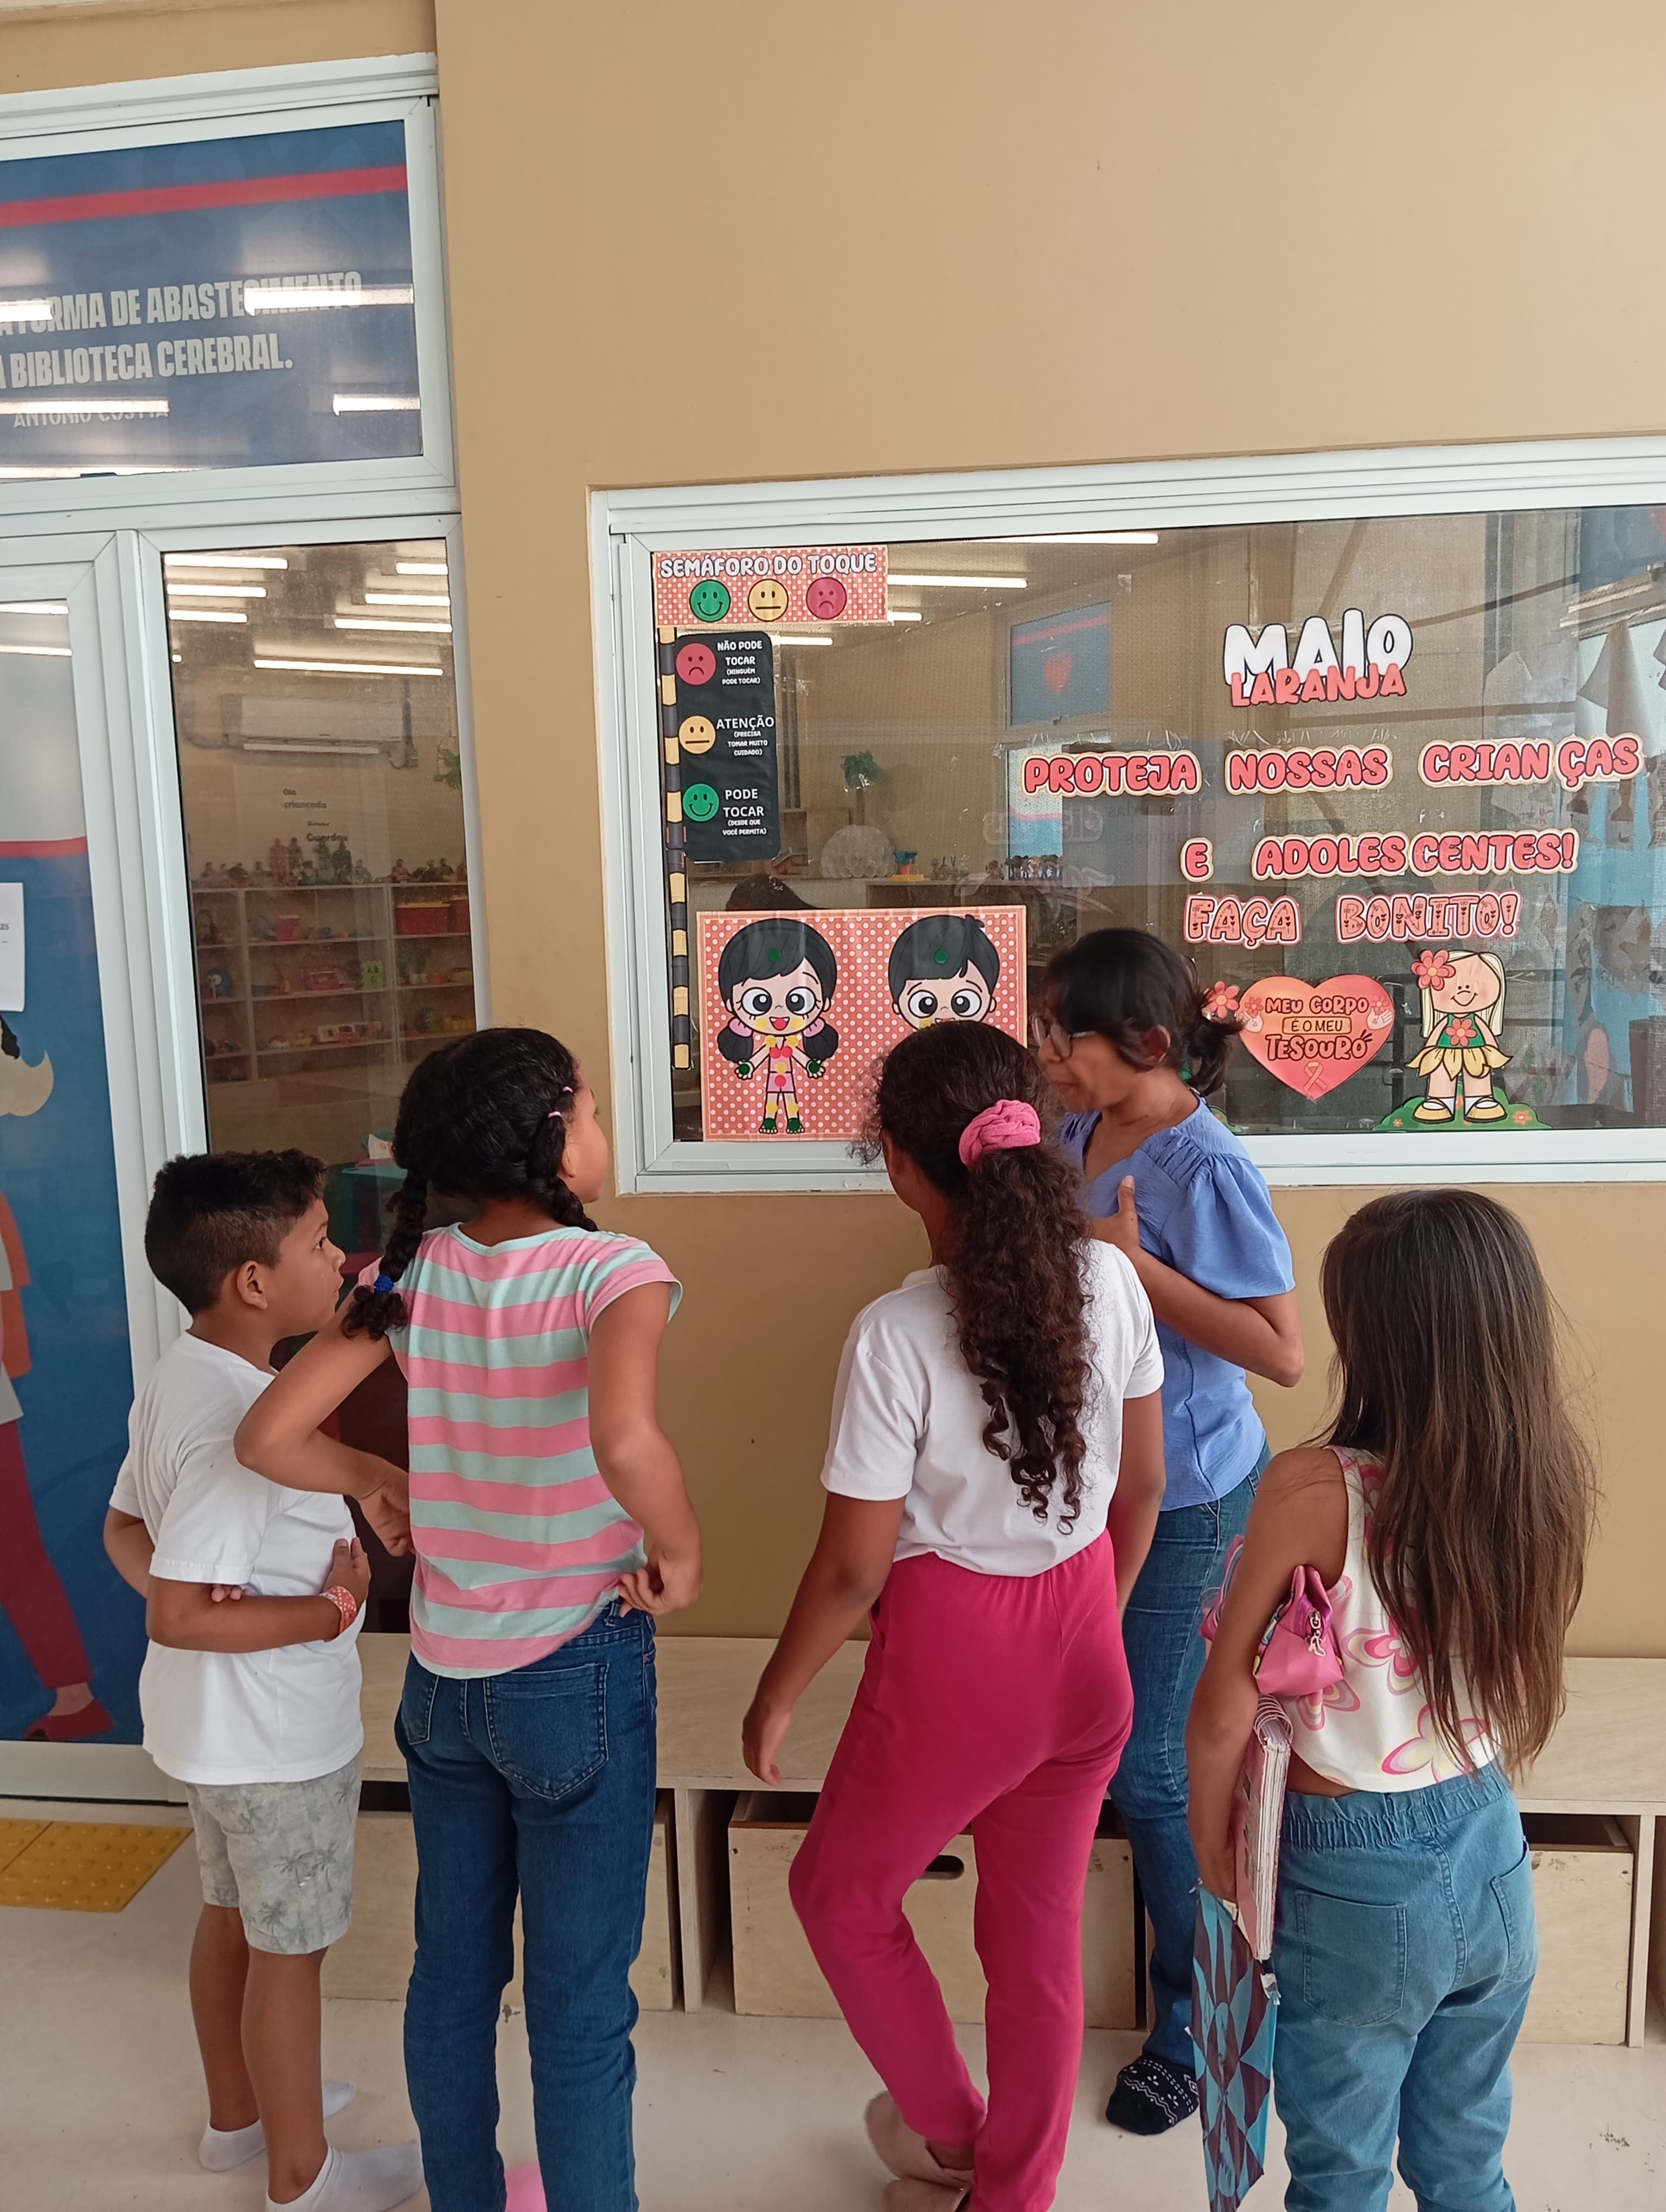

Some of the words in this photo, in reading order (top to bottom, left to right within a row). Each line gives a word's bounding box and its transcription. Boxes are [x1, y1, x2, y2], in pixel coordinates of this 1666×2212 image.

[111, 289, 142, 326] DE
[10, 343, 153, 389] BIBLIOTECA
[157, 333, 293, 377] CEREBRAL.
[660, 554, 768, 578] SEMÁFORO
[773, 556, 803, 575] DO
[808, 553, 876, 575] TOQUE
[717, 640, 736, 651] NÃO
[738, 640, 762, 650] PODE
[1223, 608, 1413, 686] MAIO
[725, 656, 755, 666] TOCAR
[739, 677, 761, 685] TOCAR)
[1231, 663, 1407, 707] LARANJA
[716, 715, 774, 730] ATENÇÃO
[1024, 754, 1197, 793] PROTEJA
[1229, 744, 1388, 792] NOSSAS
[725, 788, 758, 800] PODE
[723, 806, 764, 818] TOCAR
[739, 827, 767, 835] PERMITA)
[1185, 842, 1209, 878] E
[1186, 898, 1298, 947] FAÇA
[1340, 893, 1518, 940] BONITO!
[1265, 997, 1304, 1014] MEU
[1309, 995, 1369, 1015] CORPO
[1291, 1018, 1299, 1032] É
[1302, 1020, 1312, 1032] O
[1315, 1020, 1343, 1032] MEU
[1265, 1033, 1368, 1061] TESOURO
